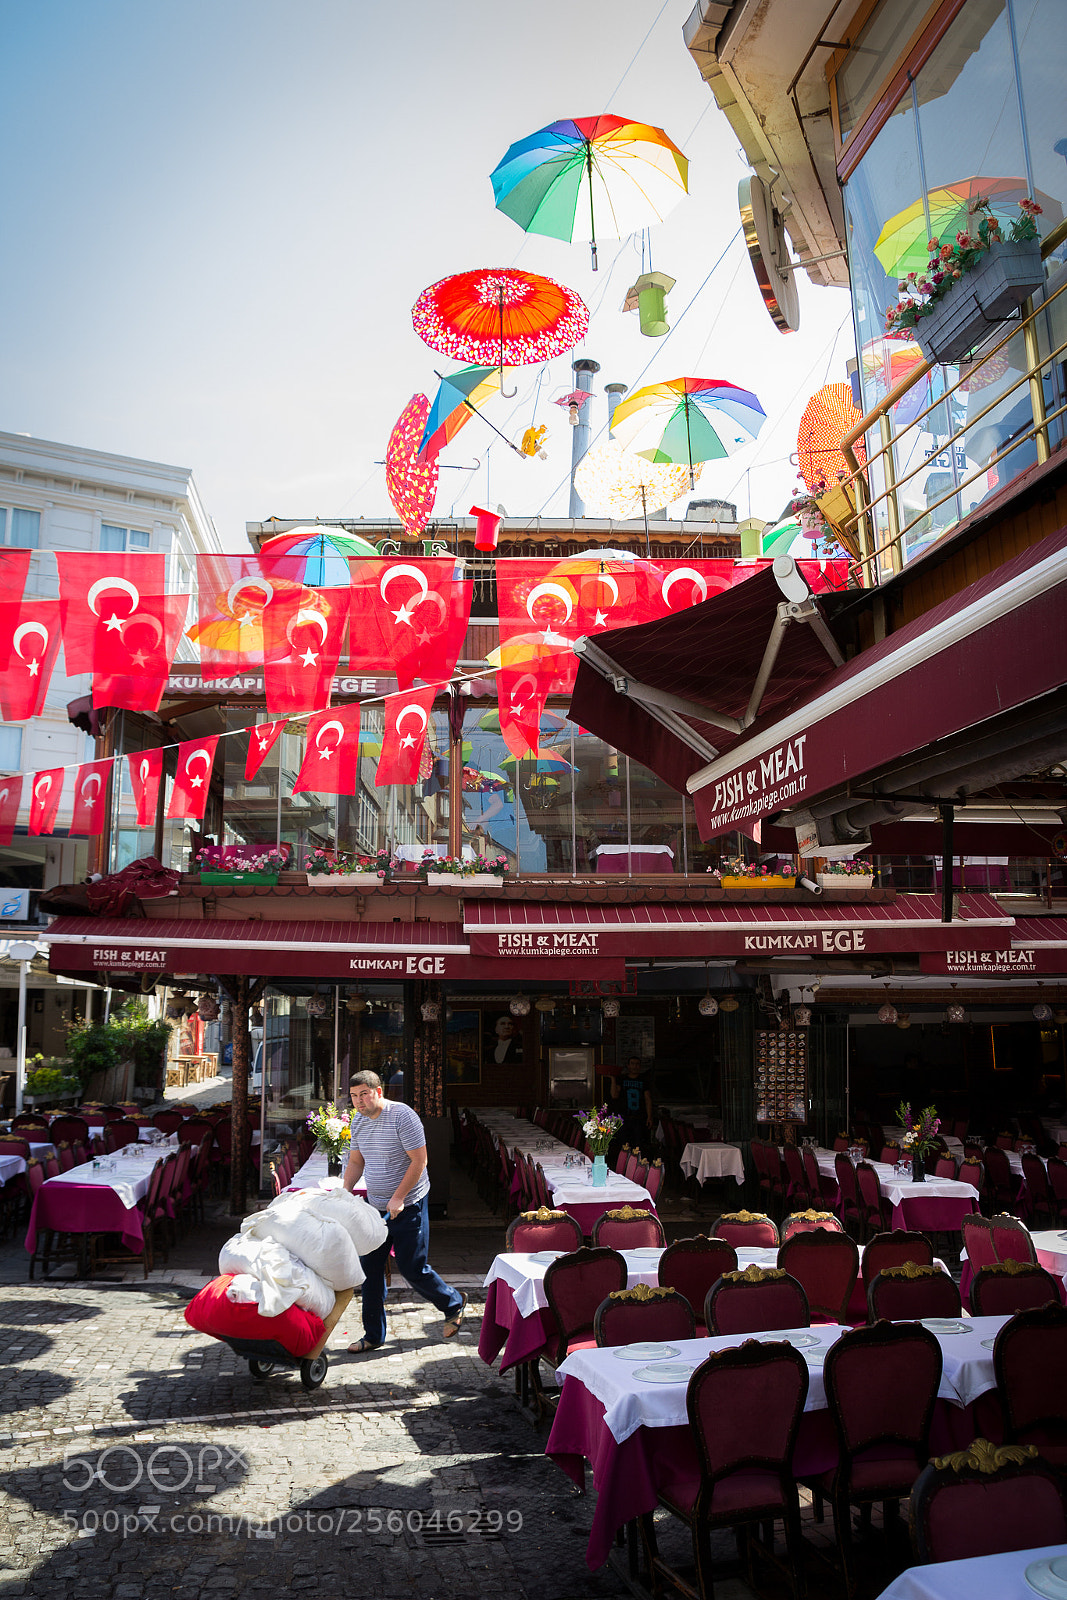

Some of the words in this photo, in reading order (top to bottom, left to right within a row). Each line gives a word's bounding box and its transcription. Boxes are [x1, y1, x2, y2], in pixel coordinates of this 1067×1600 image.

[168, 676, 263, 690] KUMKAPI
[711, 771, 744, 812] FISH
[746, 769, 759, 795] &
[759, 734, 807, 790] MEAT
[710, 774, 808, 830] www.kumkapiege.com.tr
[498, 933, 533, 947] FISH
[536, 936, 550, 946] &
[552, 933, 599, 947] MEAT
[744, 935, 818, 949] KUMKAPI
[821, 930, 866, 952] EGE
[93, 949, 118, 960] FISH
[121, 951, 132, 961] &
[134, 950, 167, 962] MEAT
[946, 950, 978, 964] FISH
[980, 952, 993, 963] &
[994, 950, 1035, 963] MEAT
[349, 959, 403, 970] KUMKAPI
[406, 956, 446, 974] EGE
[947, 963, 1037, 972] www.kumkapiege.com.tr
